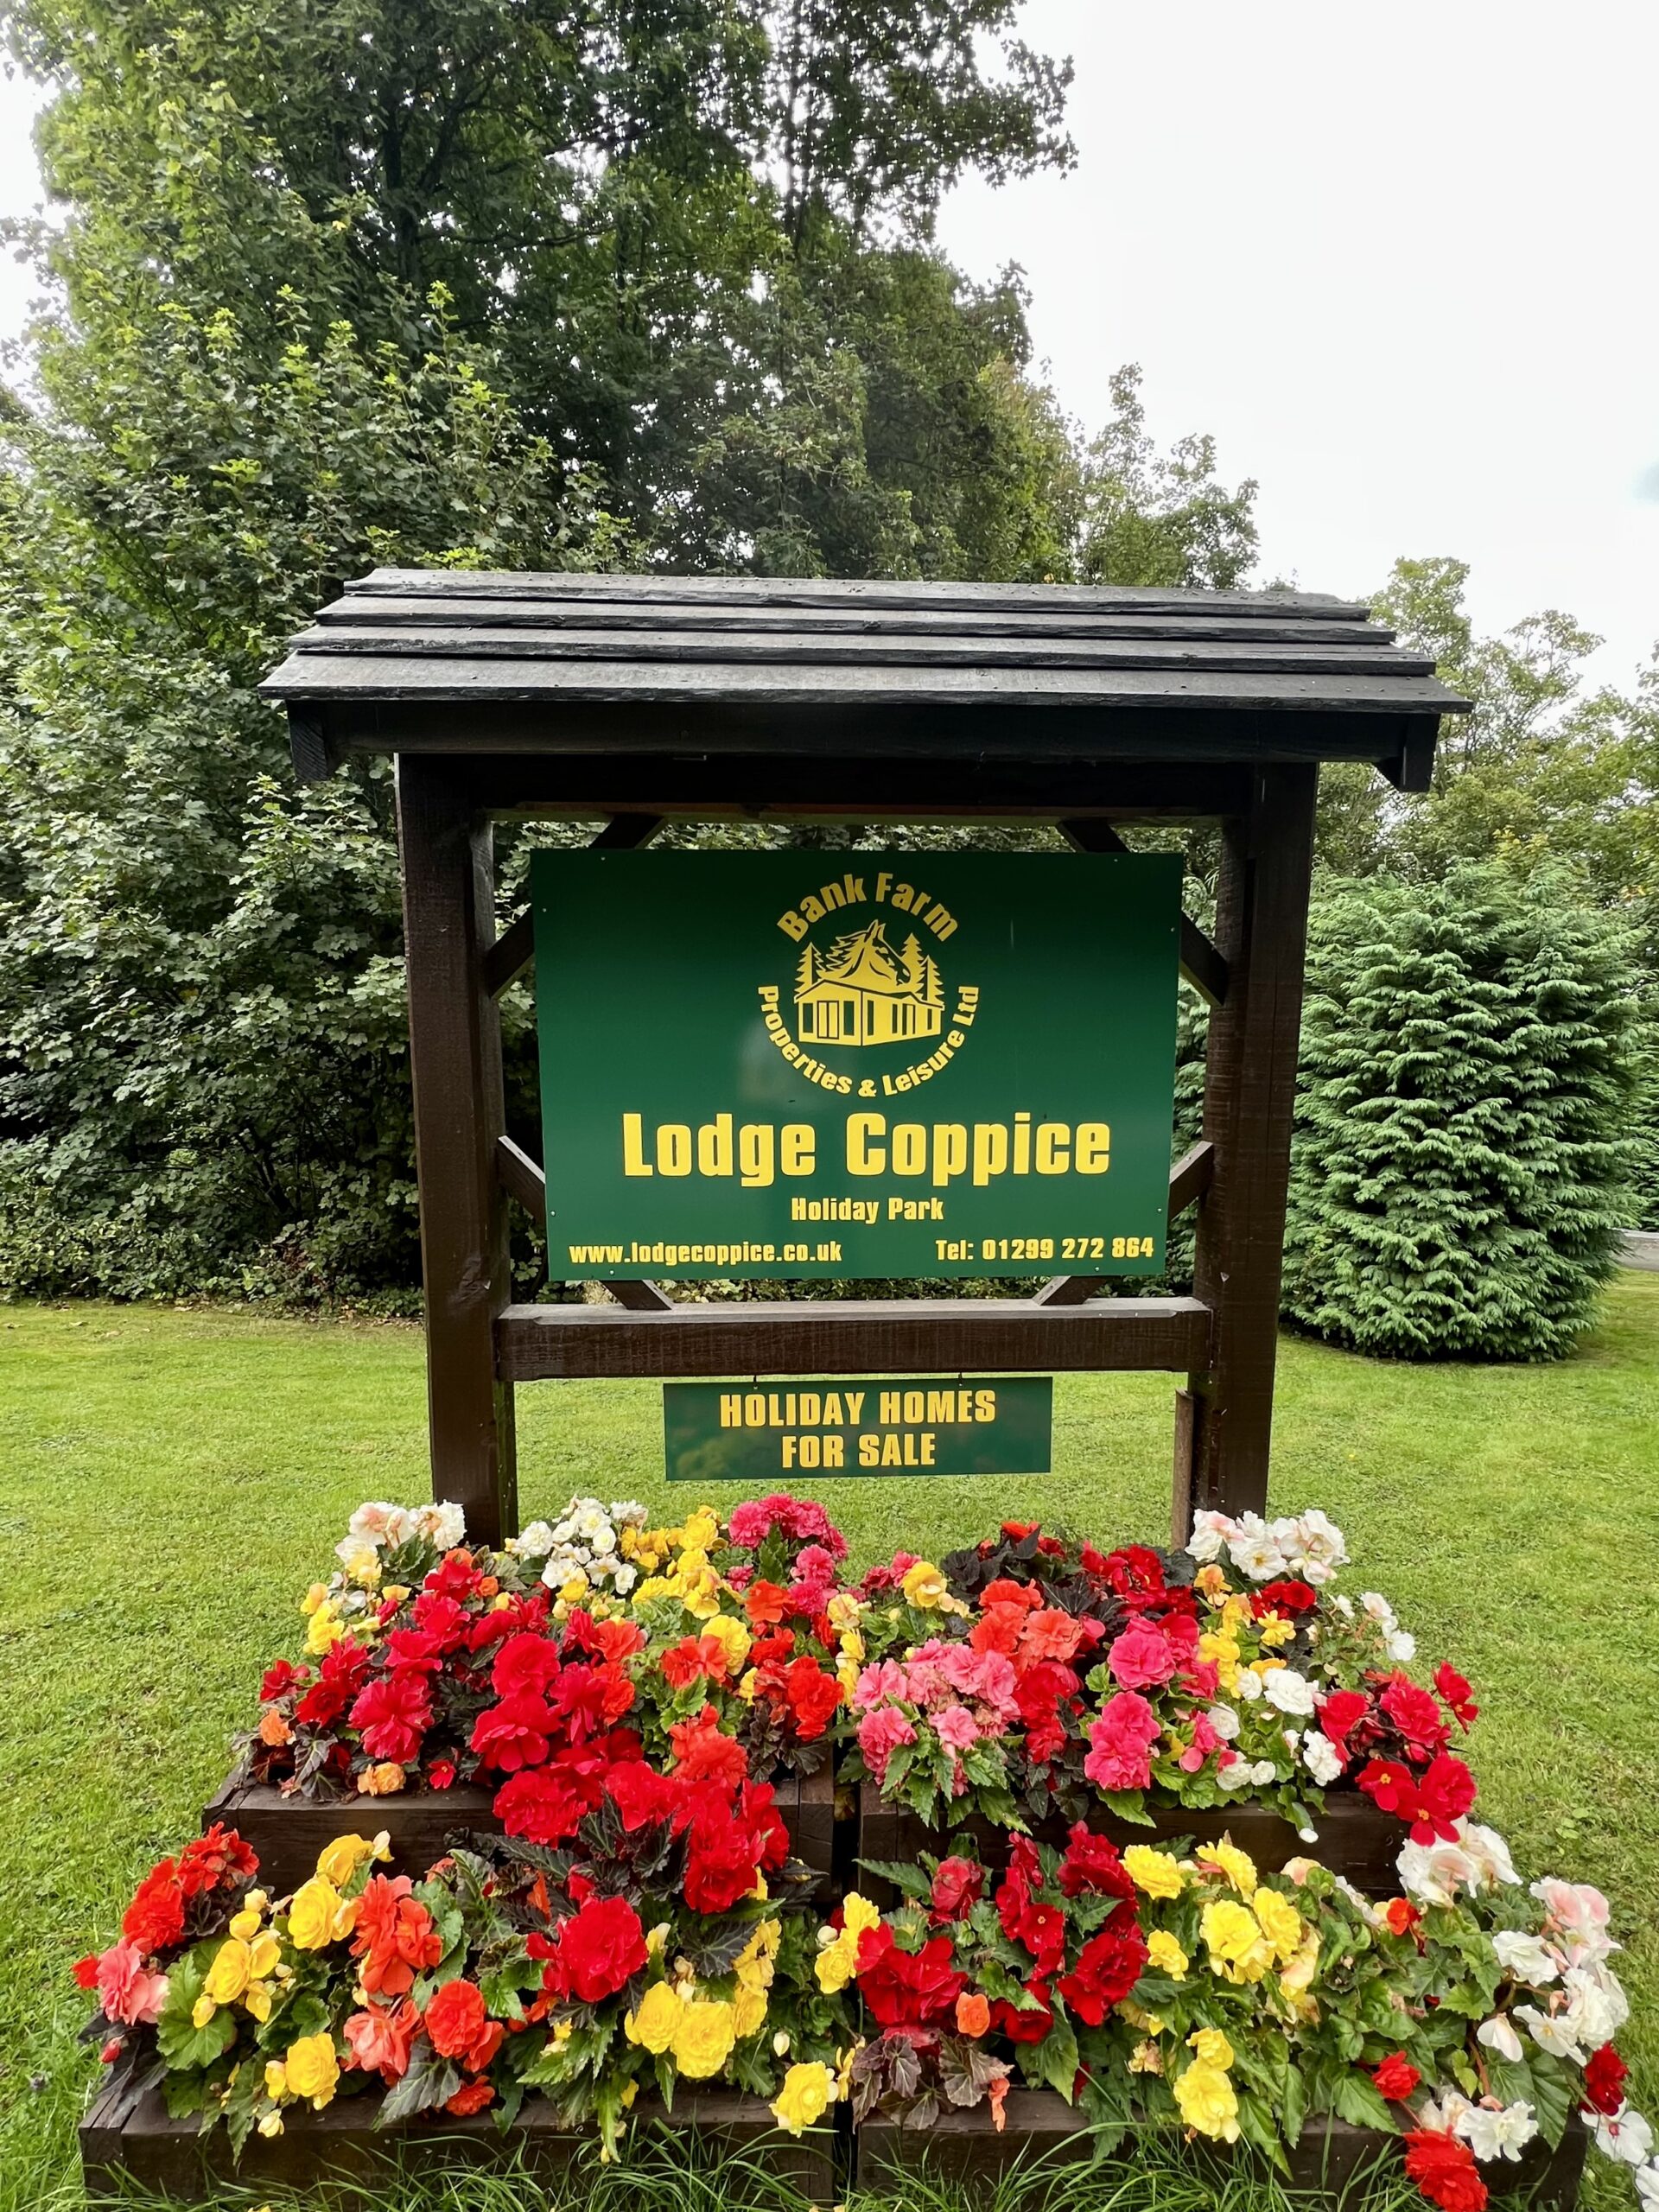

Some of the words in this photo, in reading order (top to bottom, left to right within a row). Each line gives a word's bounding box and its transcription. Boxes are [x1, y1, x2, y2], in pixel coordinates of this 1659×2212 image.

[777, 874, 867, 942] Bank
[875, 873, 958, 942] Farm
[758, 985, 853, 1094] Properties
[858, 1079, 877, 1097] &
[882, 1030, 965, 1096] Leisure
[952, 986, 979, 1027] Ltd
[622, 1113, 816, 1187] Lodge
[846, 1111, 1111, 1187] Coppice
[791, 1197, 880, 1224] Holiday
[888, 1197, 944, 1221] Park
[569, 1240, 842, 1267] www.lodgecoppice.co.uk
[935, 1239, 975, 1261] Tel:
[982, 1238, 1054, 1261] 01299
[1061, 1237, 1105, 1259] 272
[1111, 1236, 1154, 1258] 864
[720, 1392, 866, 1427] HOLIDAY
[879, 1389, 996, 1425] HOMES
[782, 1434, 844, 1469] FOR
[858, 1433, 936, 1467] SALE
